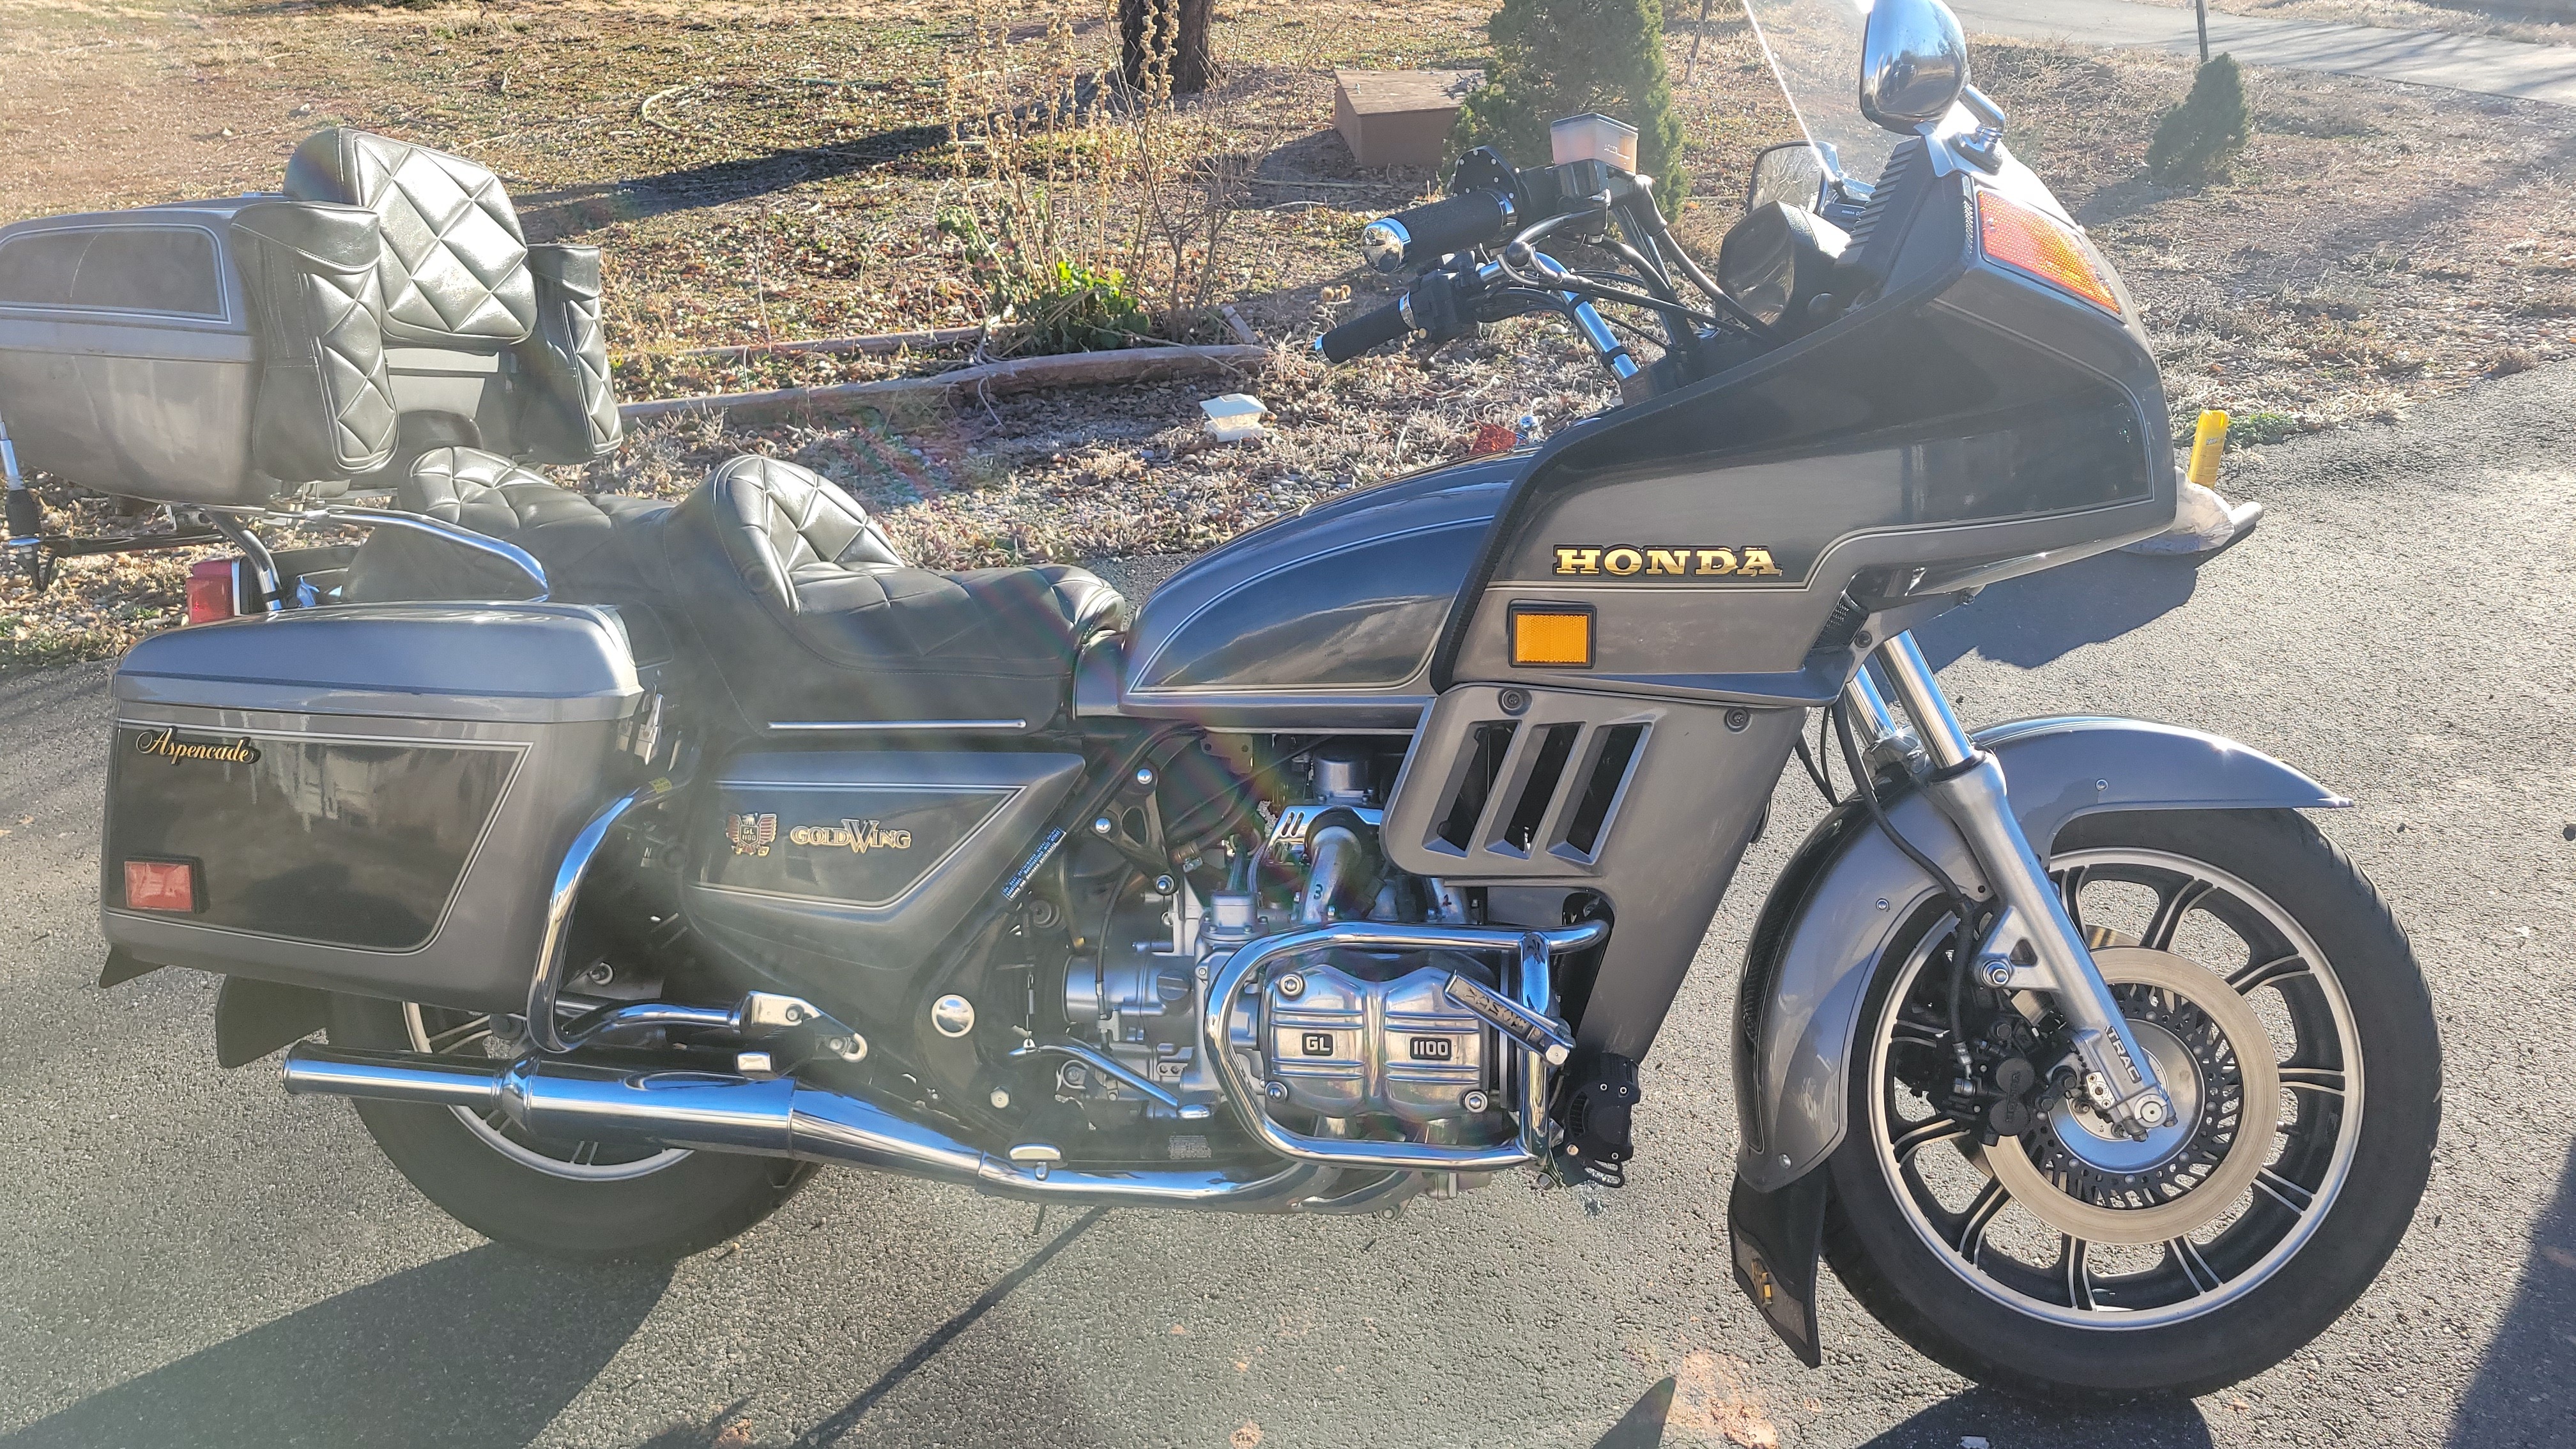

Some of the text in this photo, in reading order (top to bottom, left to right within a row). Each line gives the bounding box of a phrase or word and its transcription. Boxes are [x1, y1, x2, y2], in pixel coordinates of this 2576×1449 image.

[1555, 547, 1782, 576] HONDA
[136, 726, 255, 765] Aspencade
[1314, 884, 1323, 900] 3
[1305, 1036, 1331, 1052] GL
[1413, 1040, 1449, 1056] 1100
[2107, 1026, 2142, 1082] TRAC
